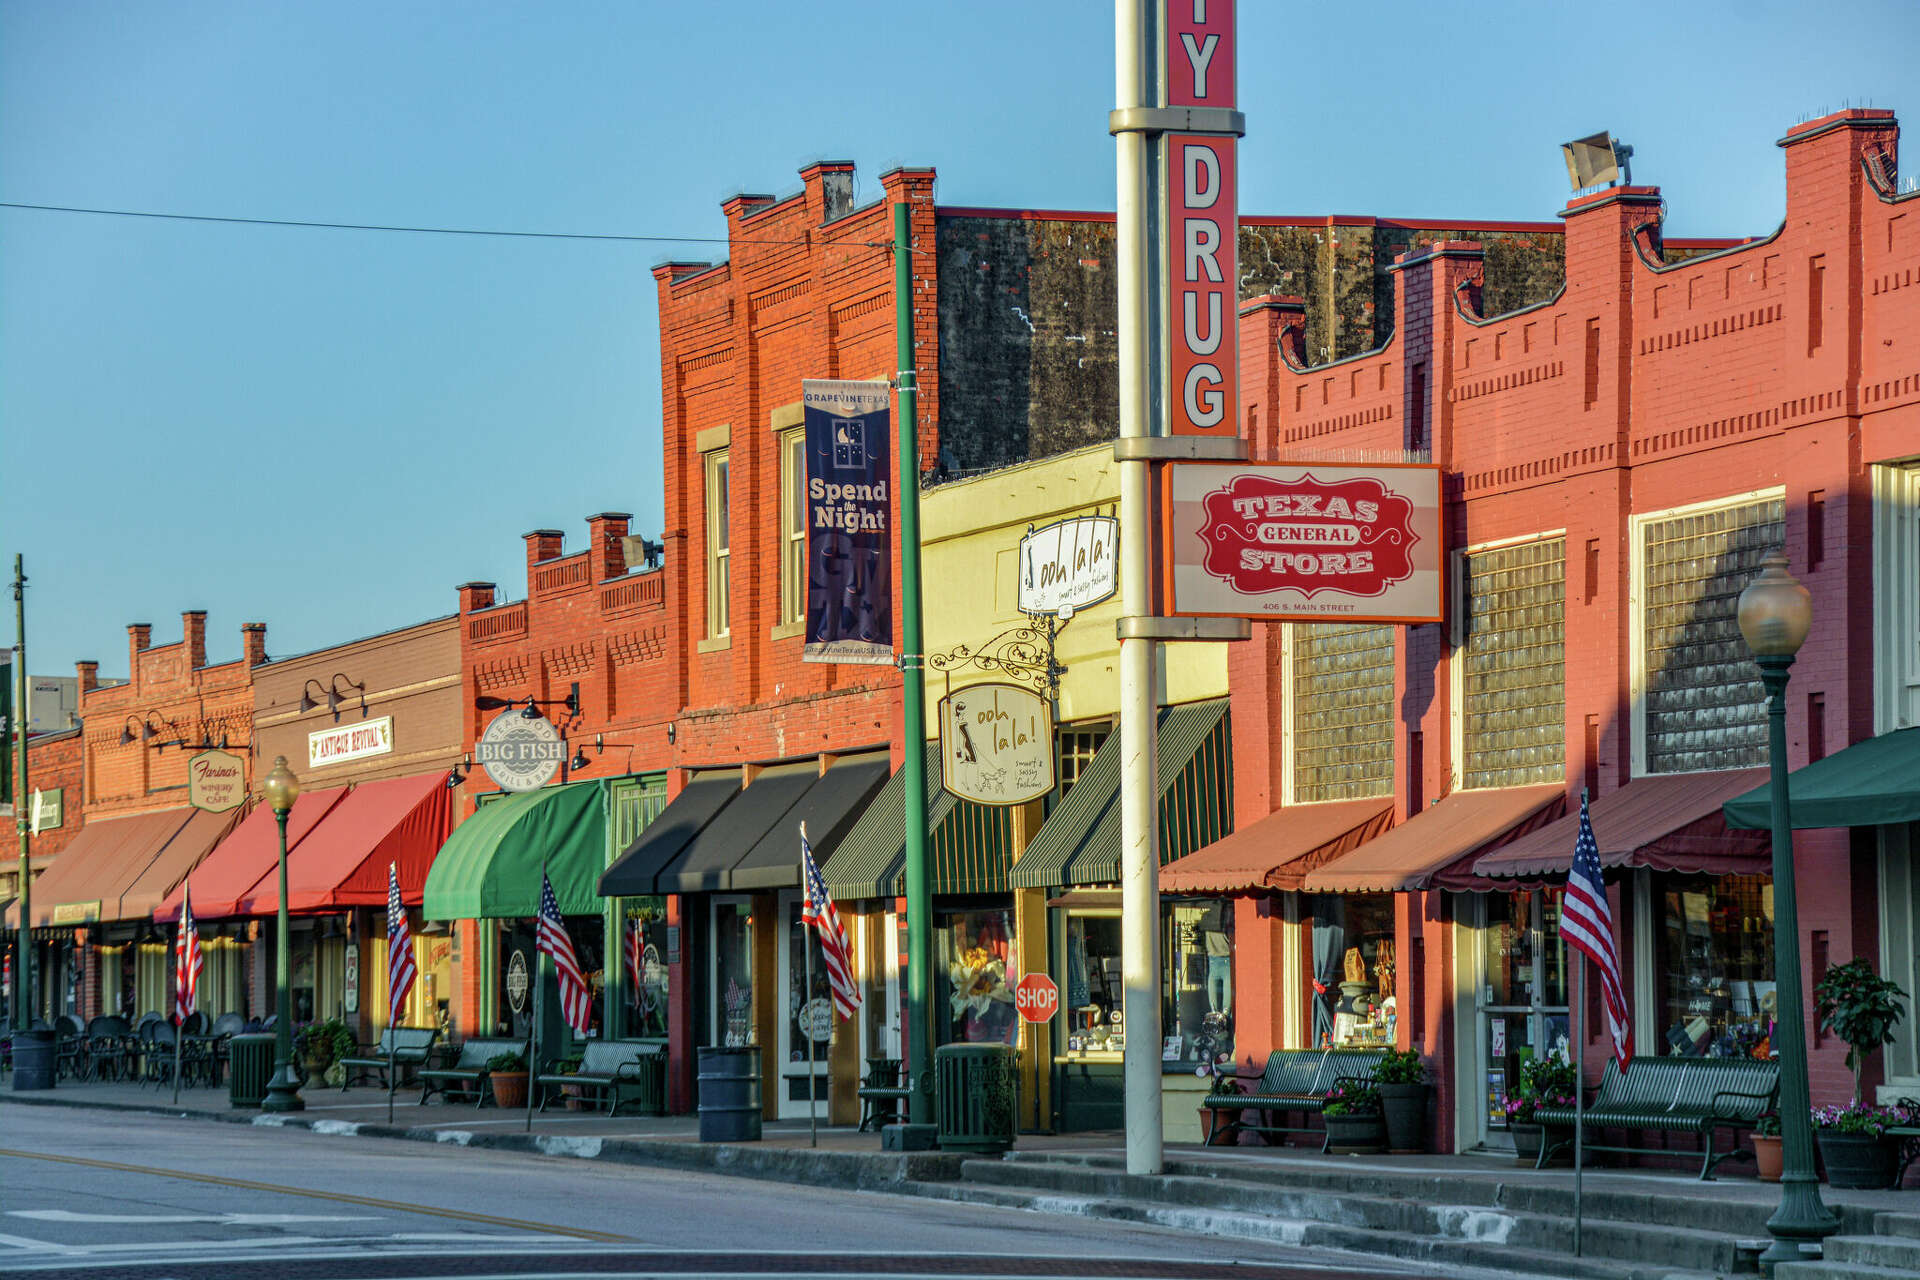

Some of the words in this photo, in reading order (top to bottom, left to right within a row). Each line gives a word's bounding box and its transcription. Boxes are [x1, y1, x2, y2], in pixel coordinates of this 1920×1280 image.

[1182, 144, 1225, 429] DRUG
[810, 478, 887, 505] Spend
[815, 506, 885, 534] Night
[844, 501, 857, 512] the
[1232, 494, 1379, 523] TEXAS
[1263, 526, 1354, 542] GENERAL
[1041, 519, 1067, 589] ooh
[1239, 548, 1374, 575] STORE
[1263, 603, 1281, 611] 406
[1293, 604, 1318, 612] MAIN
[1319, 604, 1357, 613] STREET
[977, 688, 1009, 725] ooh
[320, 732, 349, 758] ANTIQUE
[351, 726, 378, 751] REVIVAL
[481, 742, 514, 761] BIG
[519, 742, 562, 761] FISH
[493, 765, 521, 786] GRILL
[1018, 988, 1056, 1008] SHOP
